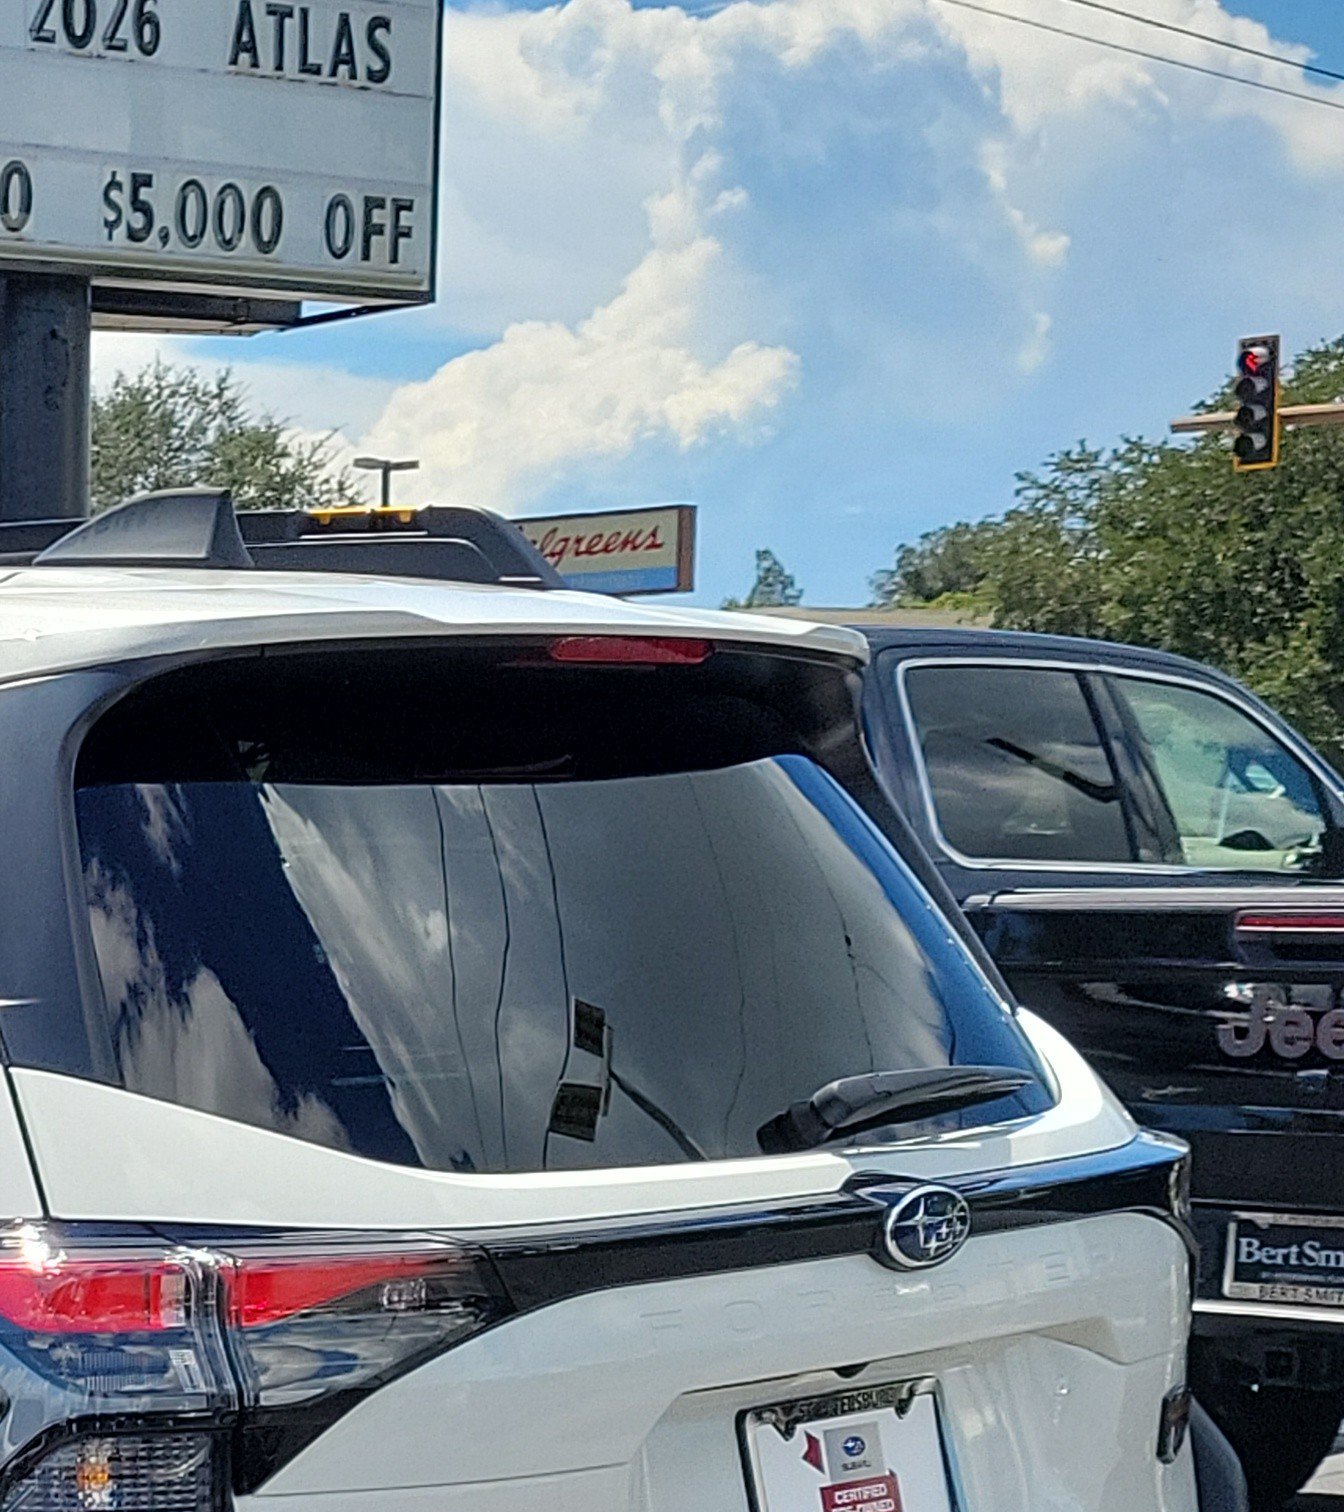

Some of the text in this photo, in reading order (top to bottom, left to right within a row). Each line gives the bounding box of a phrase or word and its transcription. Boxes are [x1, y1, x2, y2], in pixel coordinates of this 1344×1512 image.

[29, 0, 160, 56] 2026
[227, 0, 393, 83] ATLAS
[102, 170, 283, 254] $5,000
[325, 193, 414, 264] OFF
[518, 525, 664, 567] lgreens
